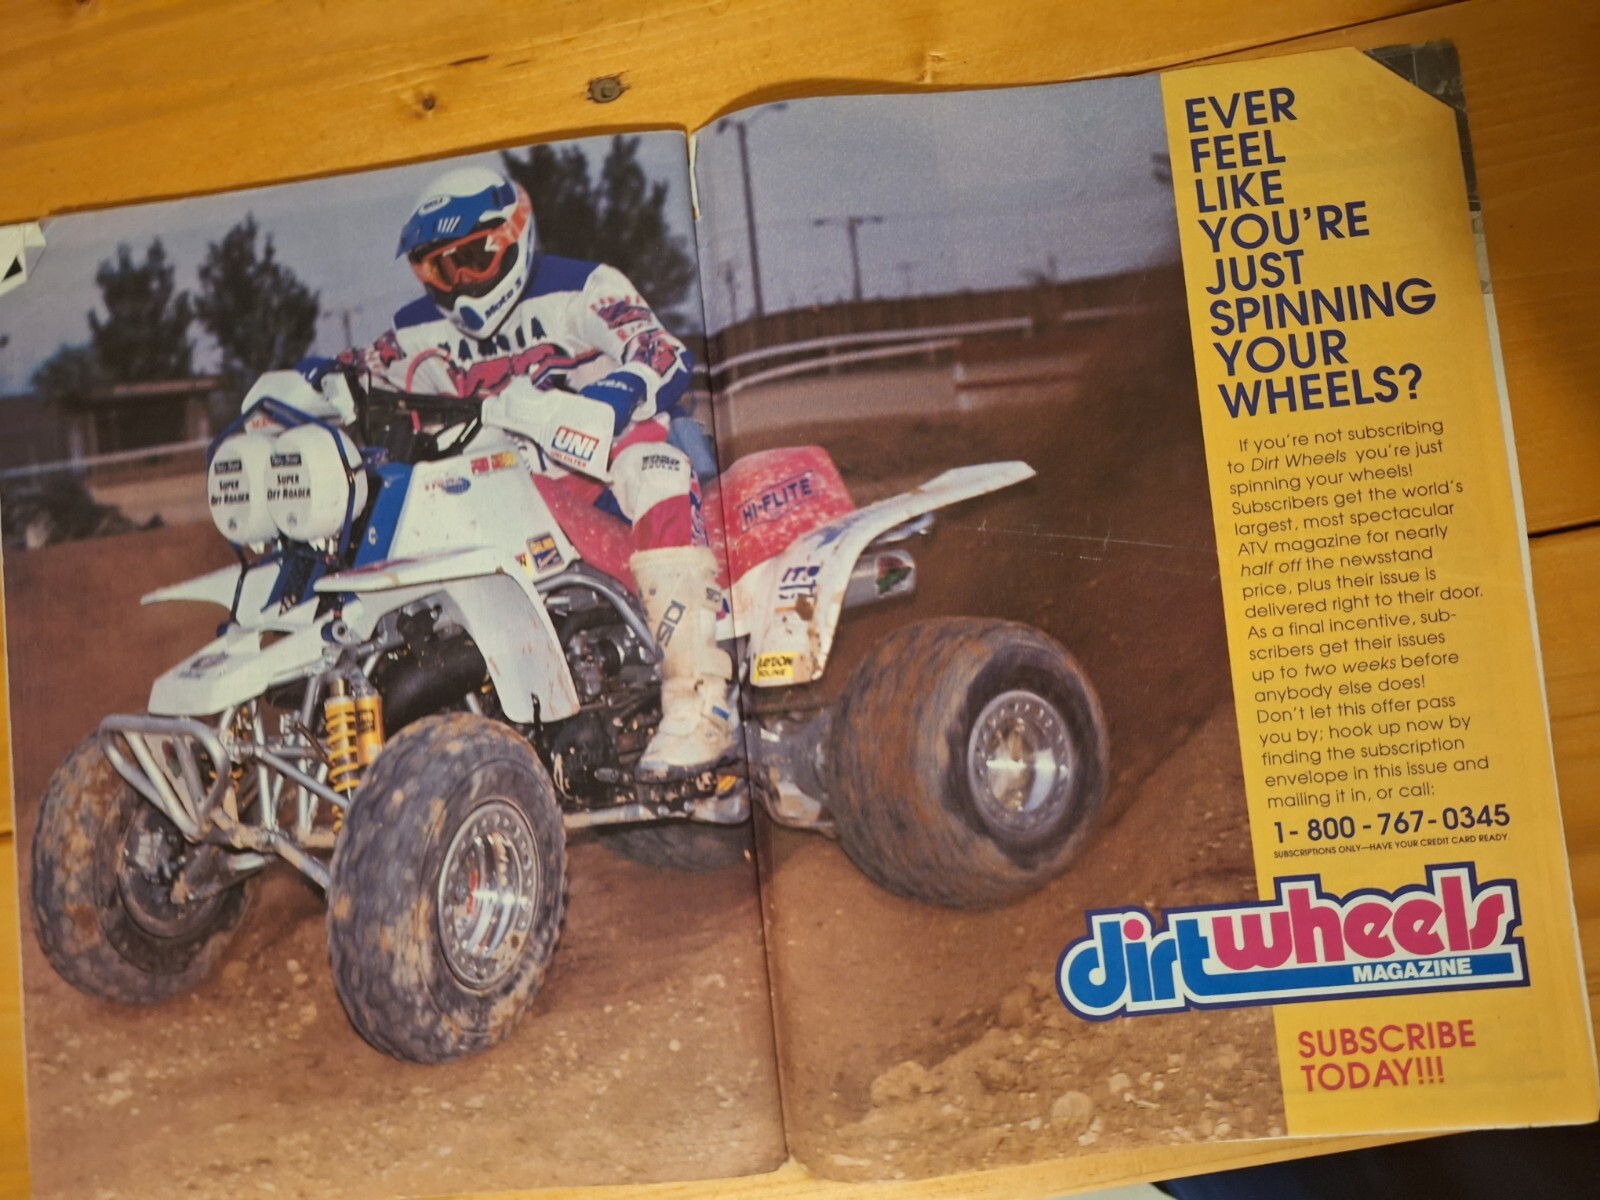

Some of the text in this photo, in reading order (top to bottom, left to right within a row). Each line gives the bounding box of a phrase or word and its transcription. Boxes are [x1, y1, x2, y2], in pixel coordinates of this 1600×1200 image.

[1184, 87, 1297, 133] EVER
[1190, 129, 1286, 173] FEEL
[1195, 169, 1285, 213] LIKE
[1198, 200, 1370, 253] YOU'RE
[1205, 249, 1304, 295] JUST
[1209, 277, 1436, 336] SPINNING
[1213, 329, 1349, 376] YOUR
[1217, 362, 1422, 418] WHEELS?
[554, 428, 597, 460] UNI
[1239, 420, 1444, 454] If you're not subscribing
[1226, 439, 1443, 474] to Dirt Wheels you're just
[1229, 463, 1413, 498] spinning your wheels!
[1231, 479, 1464, 516] Subscribers get the world's
[742, 478, 813, 525] HI-FLITE
[1234, 502, 1454, 537] largest, most spectacular
[1237, 523, 1448, 557] ATV magazine for nearly
[1240, 545, 1433, 577] half off the newsstand
[1242, 566, 1437, 601] price, plus their issue is
[1244, 586, 1483, 619] delivered right to their door.
[1247, 608, 1457, 640] As a final incentive, sub-
[1249, 632, 1446, 661] scribers get their issues
[1251, 652, 1459, 684] up to two weeks before
[1254, 674, 1425, 704] anybody else does!
[1256, 696, 1456, 724] Don't let this offer pass
[1259, 714, 1471, 748] you by; hook up now by
[1261, 737, 1465, 766] finding the subscription
[1264, 755, 1489, 788] envelope in this issue and
[1267, 781, 1435, 809] mailing it in, or call:
[1274, 846, 1336, 858] SUBSCRIPTIONS
[1395, 839, 1418, 848] YOUR
[1420, 837, 1449, 846] CREDIT
[1451, 835, 1476, 844] CARD
[1353, 957, 1472, 983] MAGAZINE
[1298, 1018, 1476, 1059] SUBSCRIBE
[1301, 1056, 1445, 1092] TODAY!!!
